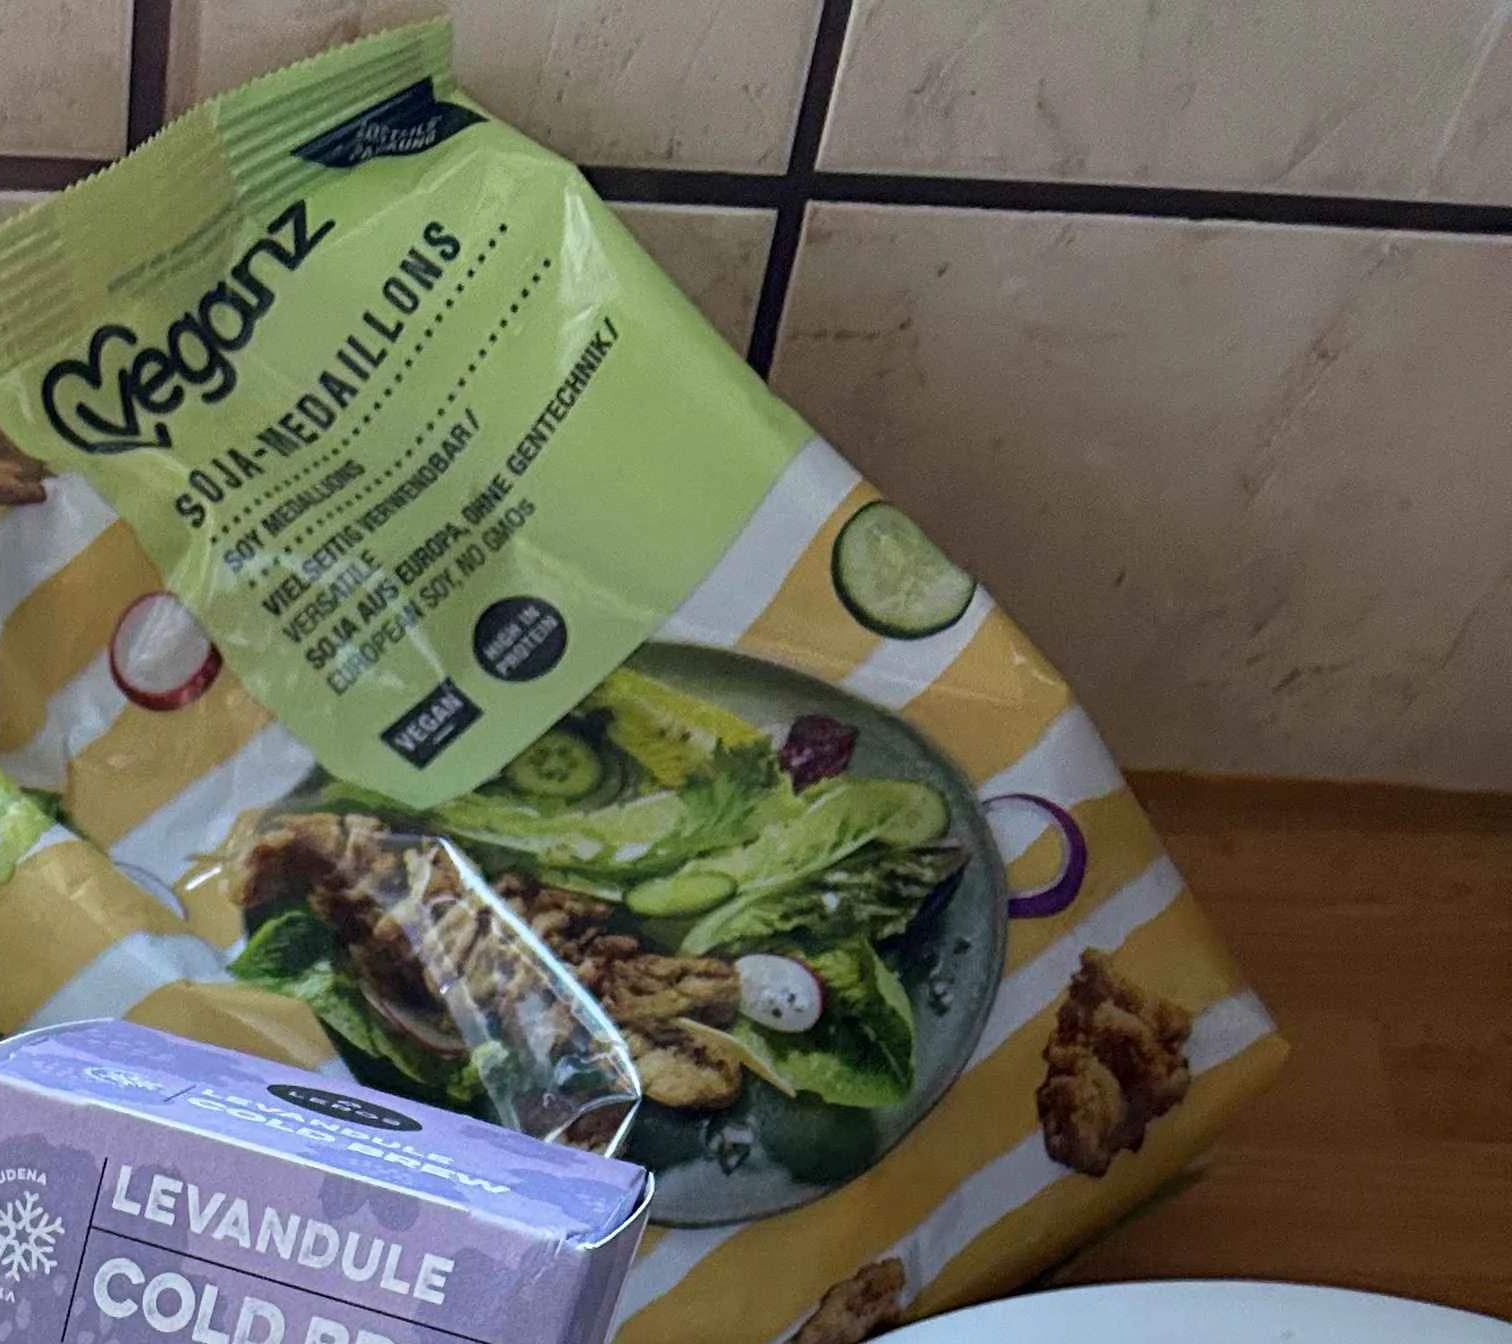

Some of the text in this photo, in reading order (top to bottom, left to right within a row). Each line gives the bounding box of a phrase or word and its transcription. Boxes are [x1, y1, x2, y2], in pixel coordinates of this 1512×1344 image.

[174, 220, 463, 530] SOJA-MEDAILLONS
[223, 459, 366, 572] SOY MEDALLIONS
[262, 525, 363, 616] VIELSEITIG
[282, 549, 383, 643] VERSATILE
[305, 617, 360, 670] SOJA
[357, 578, 399, 624] AUS
[396, 694, 462, 750] VEGAN
[187, 1096, 512, 1194] COLD BREW
[201, 1087, 456, 1164] LEVANDULE
[110, 1164, 455, 1306] LEVANDULE
